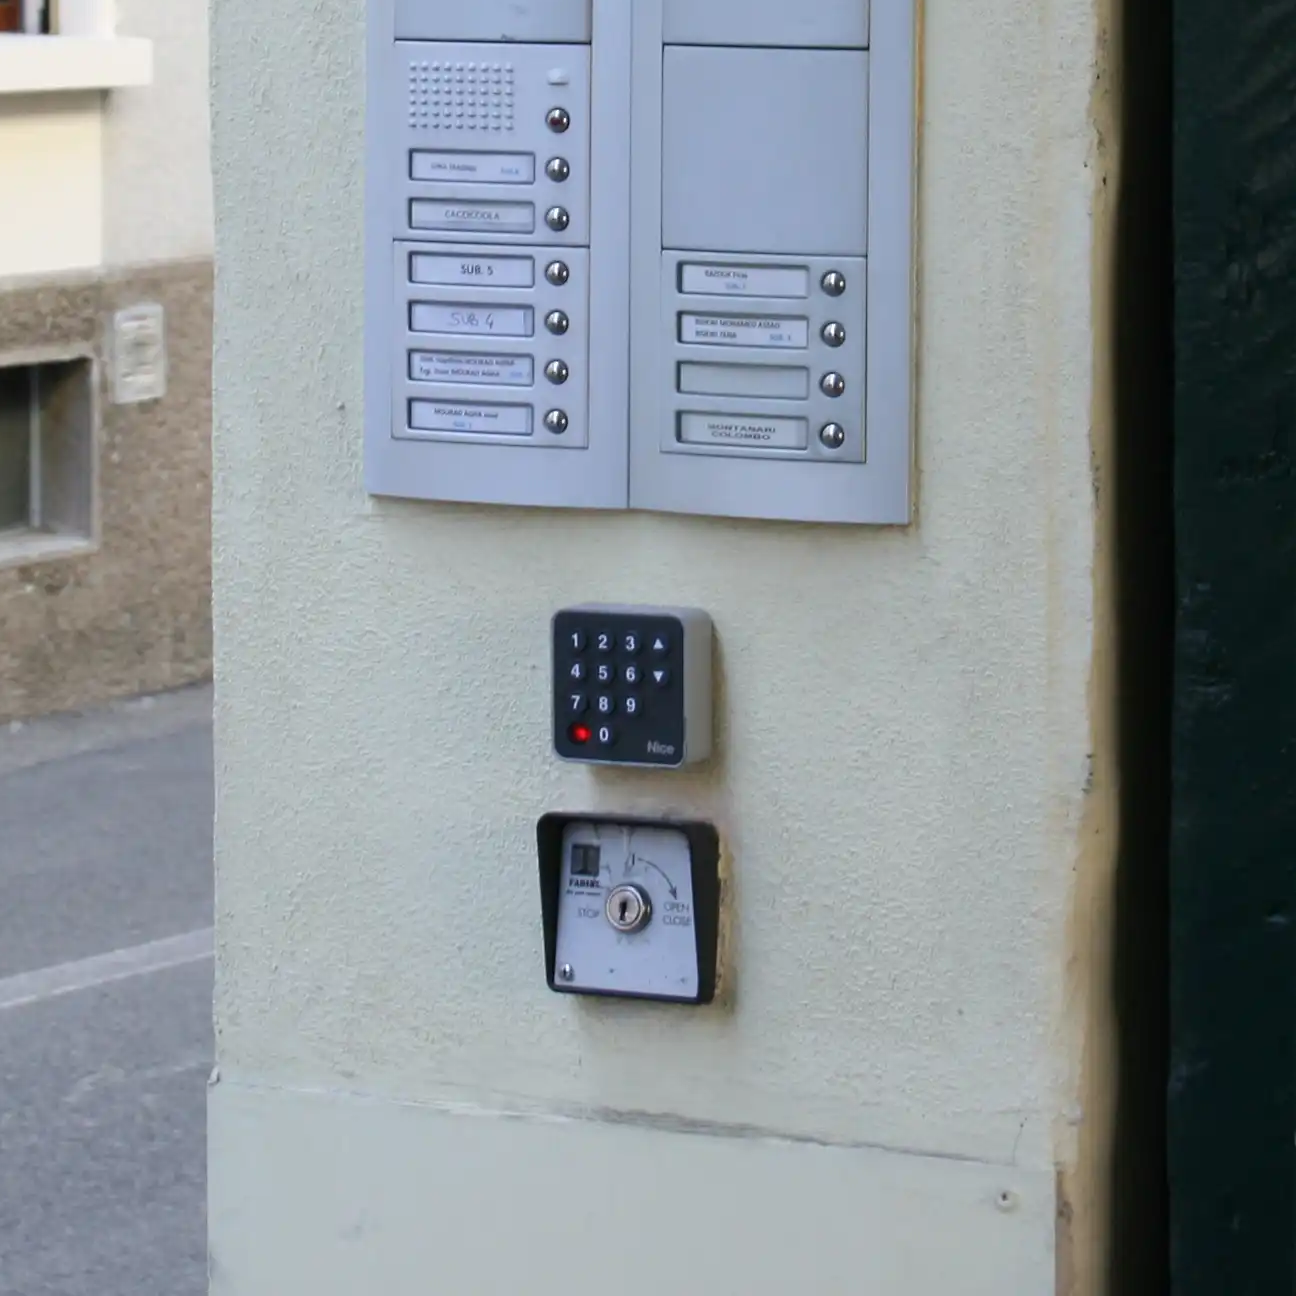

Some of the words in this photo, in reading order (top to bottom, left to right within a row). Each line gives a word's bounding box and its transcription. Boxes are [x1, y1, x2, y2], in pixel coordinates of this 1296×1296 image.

[449, 311, 479, 326] SUB
[711, 430, 771, 441] COLOMBO
[571, 632, 579, 648] 1
[598, 634, 607, 649] 2
[626, 635, 635, 651] 3
[570, 663, 580, 678] 4
[598, 665, 608, 680] 5
[626, 666, 635, 681] 6
[571, 694, 581, 709] 7
[598, 696, 608, 711] 8
[626, 698, 636, 713] 9
[599, 727, 609, 742] 0
[647, 741, 675, 755] Nice
